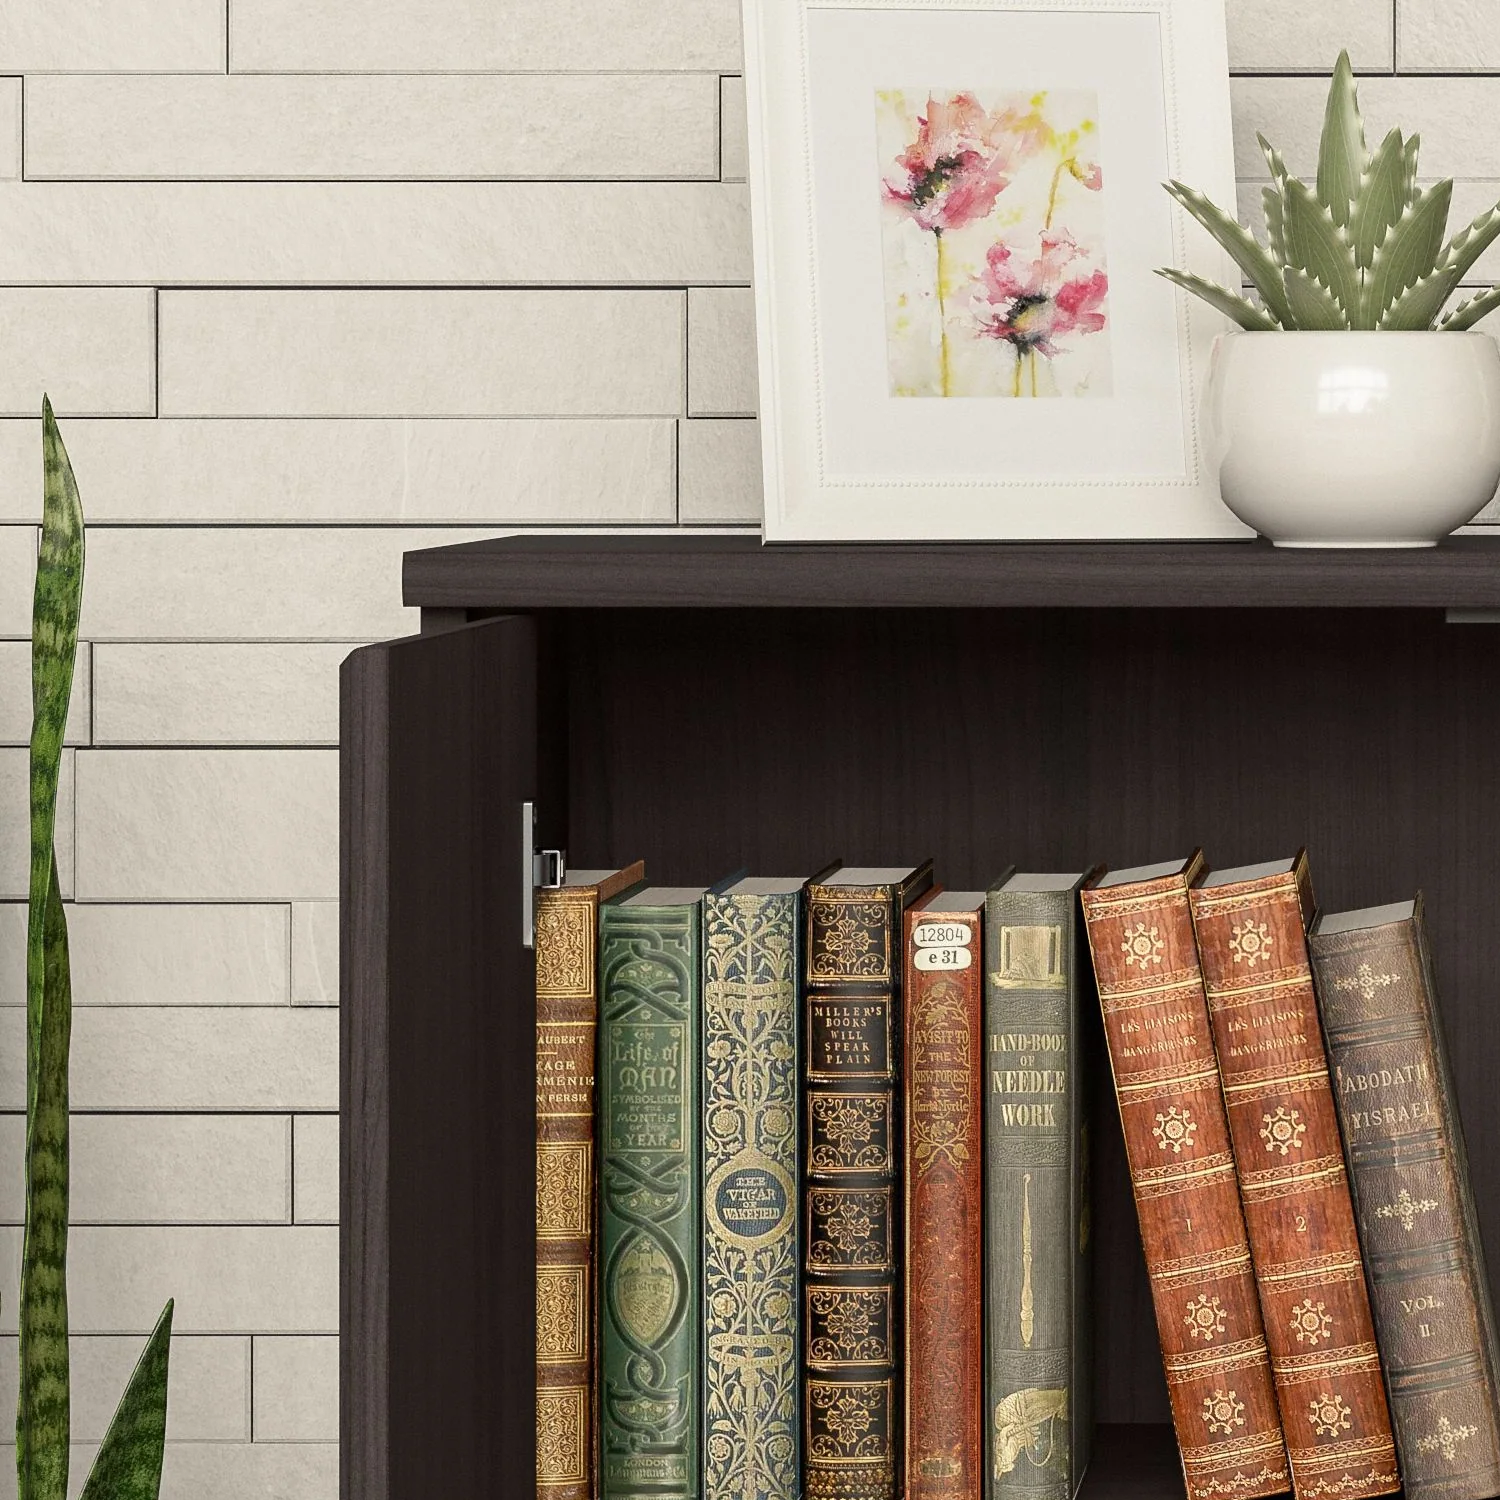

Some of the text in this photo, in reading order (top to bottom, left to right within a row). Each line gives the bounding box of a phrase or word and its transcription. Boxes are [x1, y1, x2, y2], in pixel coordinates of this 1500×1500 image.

[920, 927, 963, 942] 12804
[929, 950, 958, 964] e 31
[814, 1006, 882, 1017] MILLER'S
[825, 1017, 867, 1028] BOOKS
[830, 1030, 863, 1040] WILL
[824, 1041, 870, 1052] SPEAK
[826, 1054, 871, 1064] PLAIN
[928, 1051, 951, 1062] THE
[1020, 1055, 1035, 1066] OF
[935, 1069, 969, 1083] FOREST
[992, 1070, 1065, 1093] NEEDLE
[1001, 1103, 1056, 1127] WORK
[1351, 1101, 1436, 1129] YISRAEL
[625, 1134, 667, 1146] YEAR
[736, 1177, 766, 1187] THE
[722, 1207, 780, 1220] WAKEFIELD
[1295, 1215, 1307, 1232] 2
